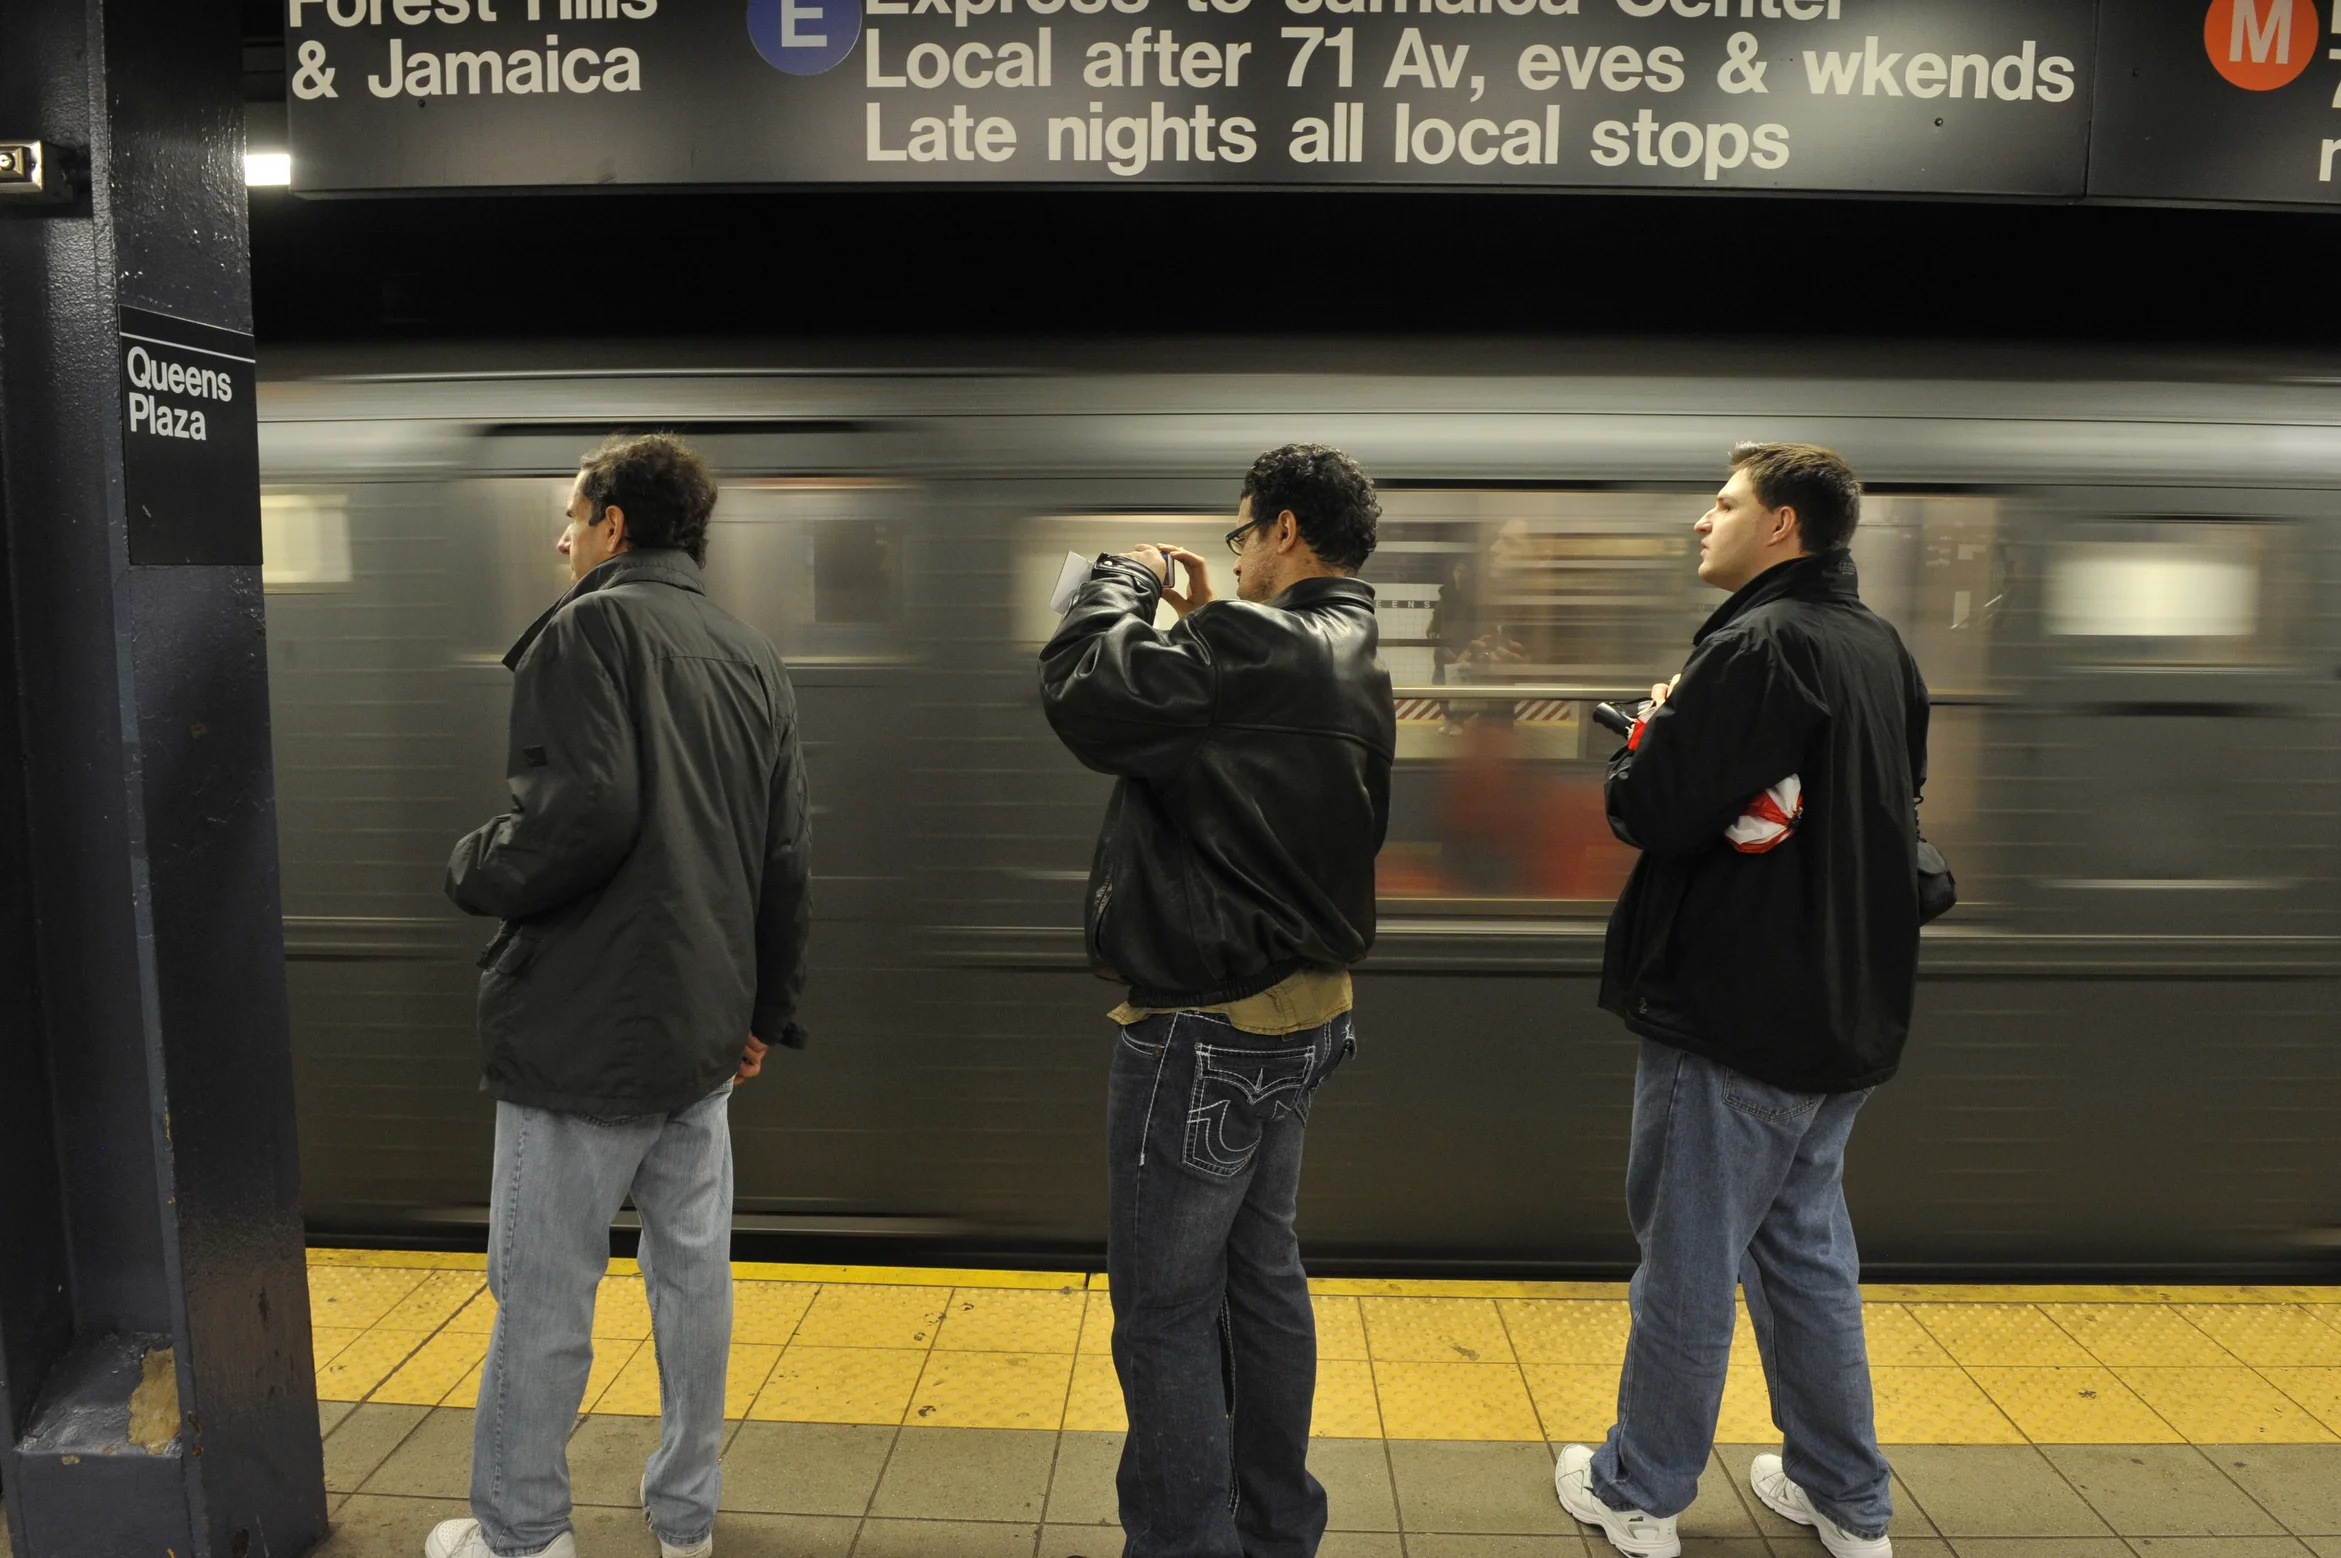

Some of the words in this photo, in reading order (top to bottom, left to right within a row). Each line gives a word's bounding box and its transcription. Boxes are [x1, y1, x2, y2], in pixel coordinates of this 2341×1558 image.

[780, 0, 830, 48] E
[2228, 0, 2293, 65] M
[291, 39, 339, 100] &
[367, 34, 642, 98] Jamaica
[866, 26, 1052, 89] Local
[1082, 26, 1252, 88] after
[1280, 26, 1354, 88] 71
[1383, 27, 1485, 102] Av,
[1517, 44, 1685, 93] eves
[1716, 31, 1770, 94] &
[1803, 36, 2075, 102] wkends
[866, 102, 1017, 163] Late
[1047, 101, 1257, 177] nights
[1288, 102, 1364, 163] all
[1394, 102, 1561, 166] local
[1590, 109, 1791, 181] stops
[127, 346, 233, 402] Queens
[129, 392, 207, 441] Plaza
[1375, 600, 1431, 609] EENS
